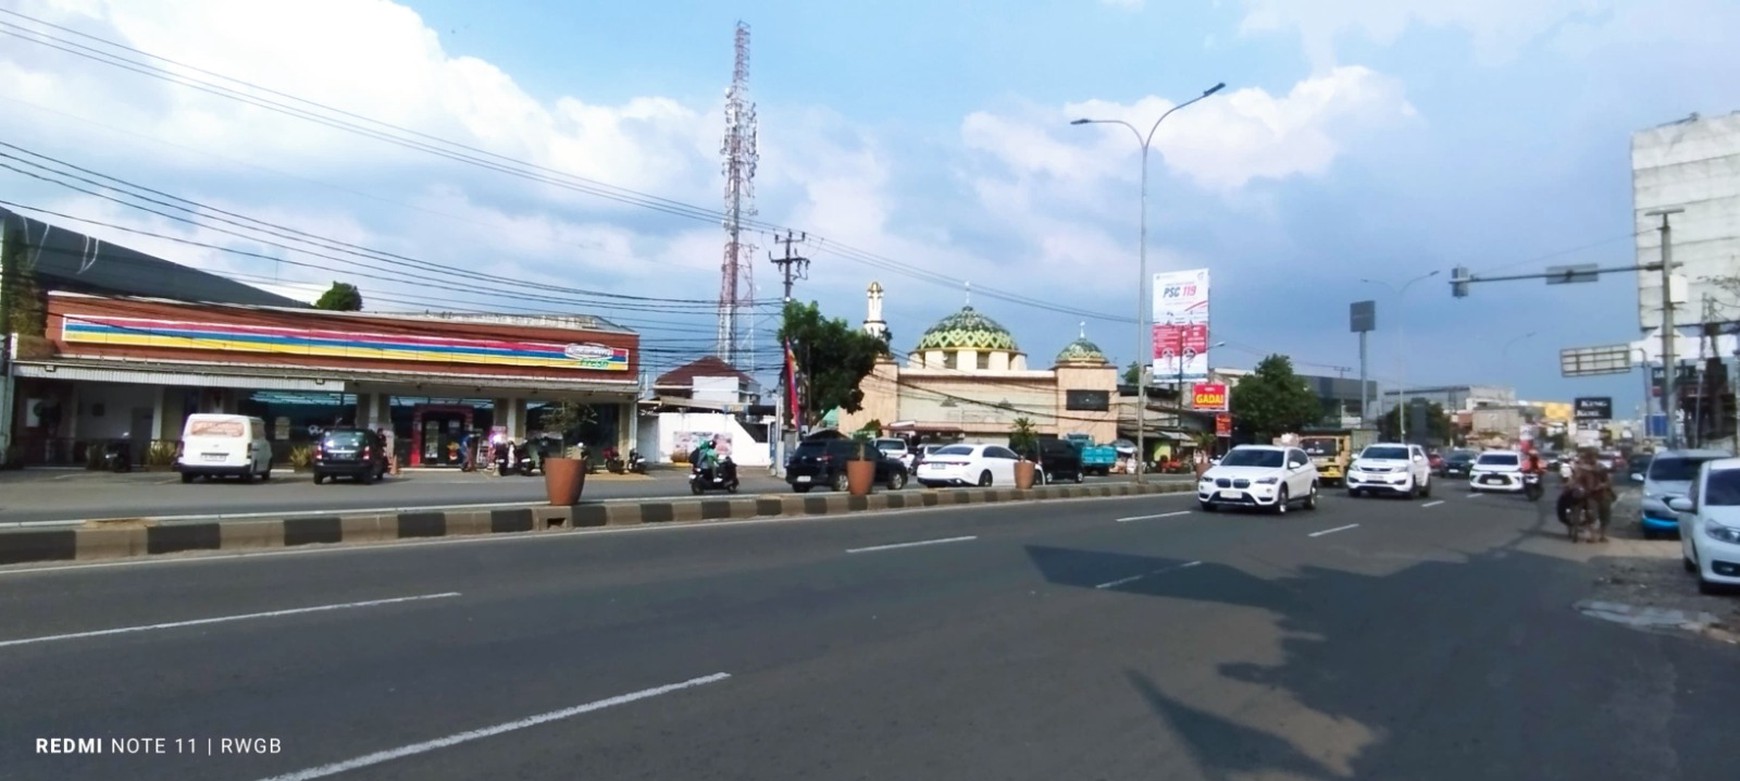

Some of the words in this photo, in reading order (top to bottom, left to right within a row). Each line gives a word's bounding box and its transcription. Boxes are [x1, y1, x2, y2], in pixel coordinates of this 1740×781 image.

[1163, 287, 1180, 298] PSC
[1183, 285, 1197, 297] 119
[1196, 393, 1224, 404] GADAI
